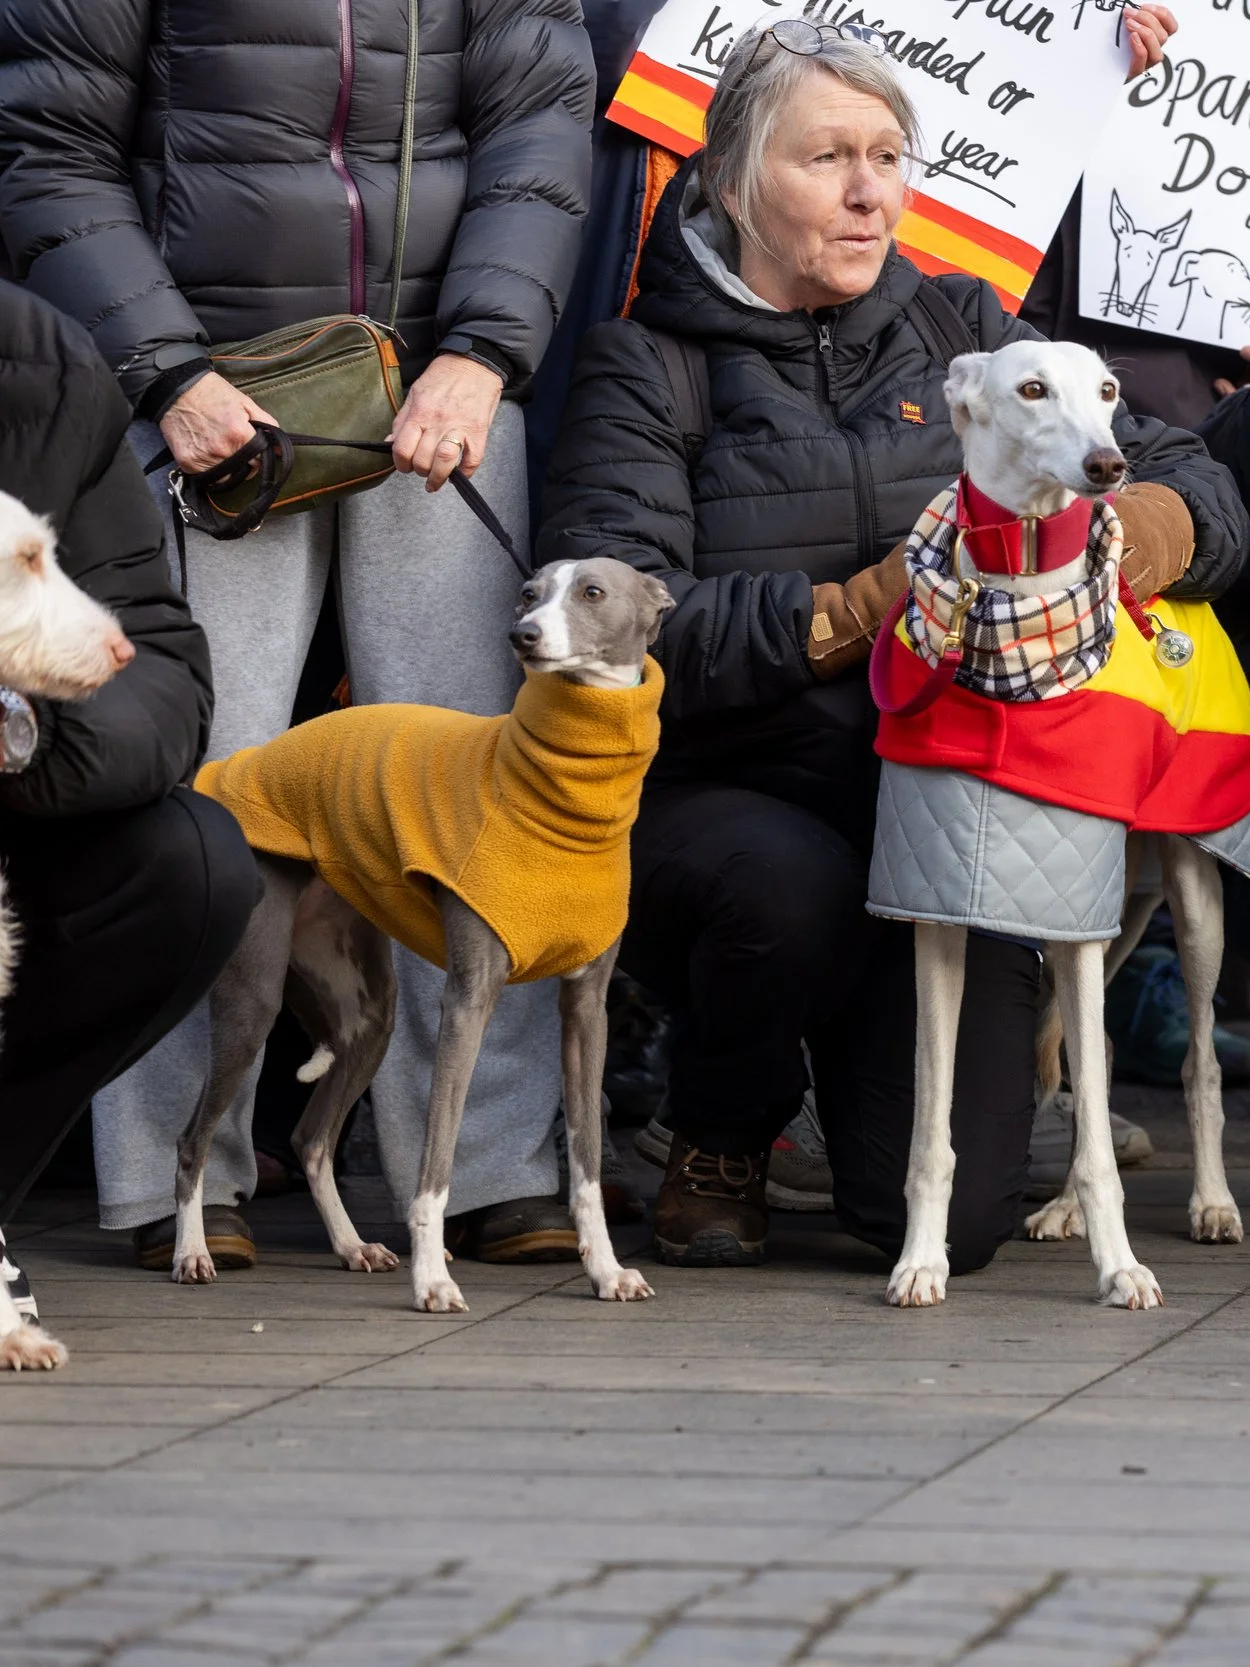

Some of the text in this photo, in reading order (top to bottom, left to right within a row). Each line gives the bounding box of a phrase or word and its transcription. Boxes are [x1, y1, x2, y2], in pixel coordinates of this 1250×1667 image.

[945, 0, 1053, 43] ain
[988, 81, 1034, 115] or
[924, 130, 1019, 180] year
[903, 404, 921, 412] FREE
